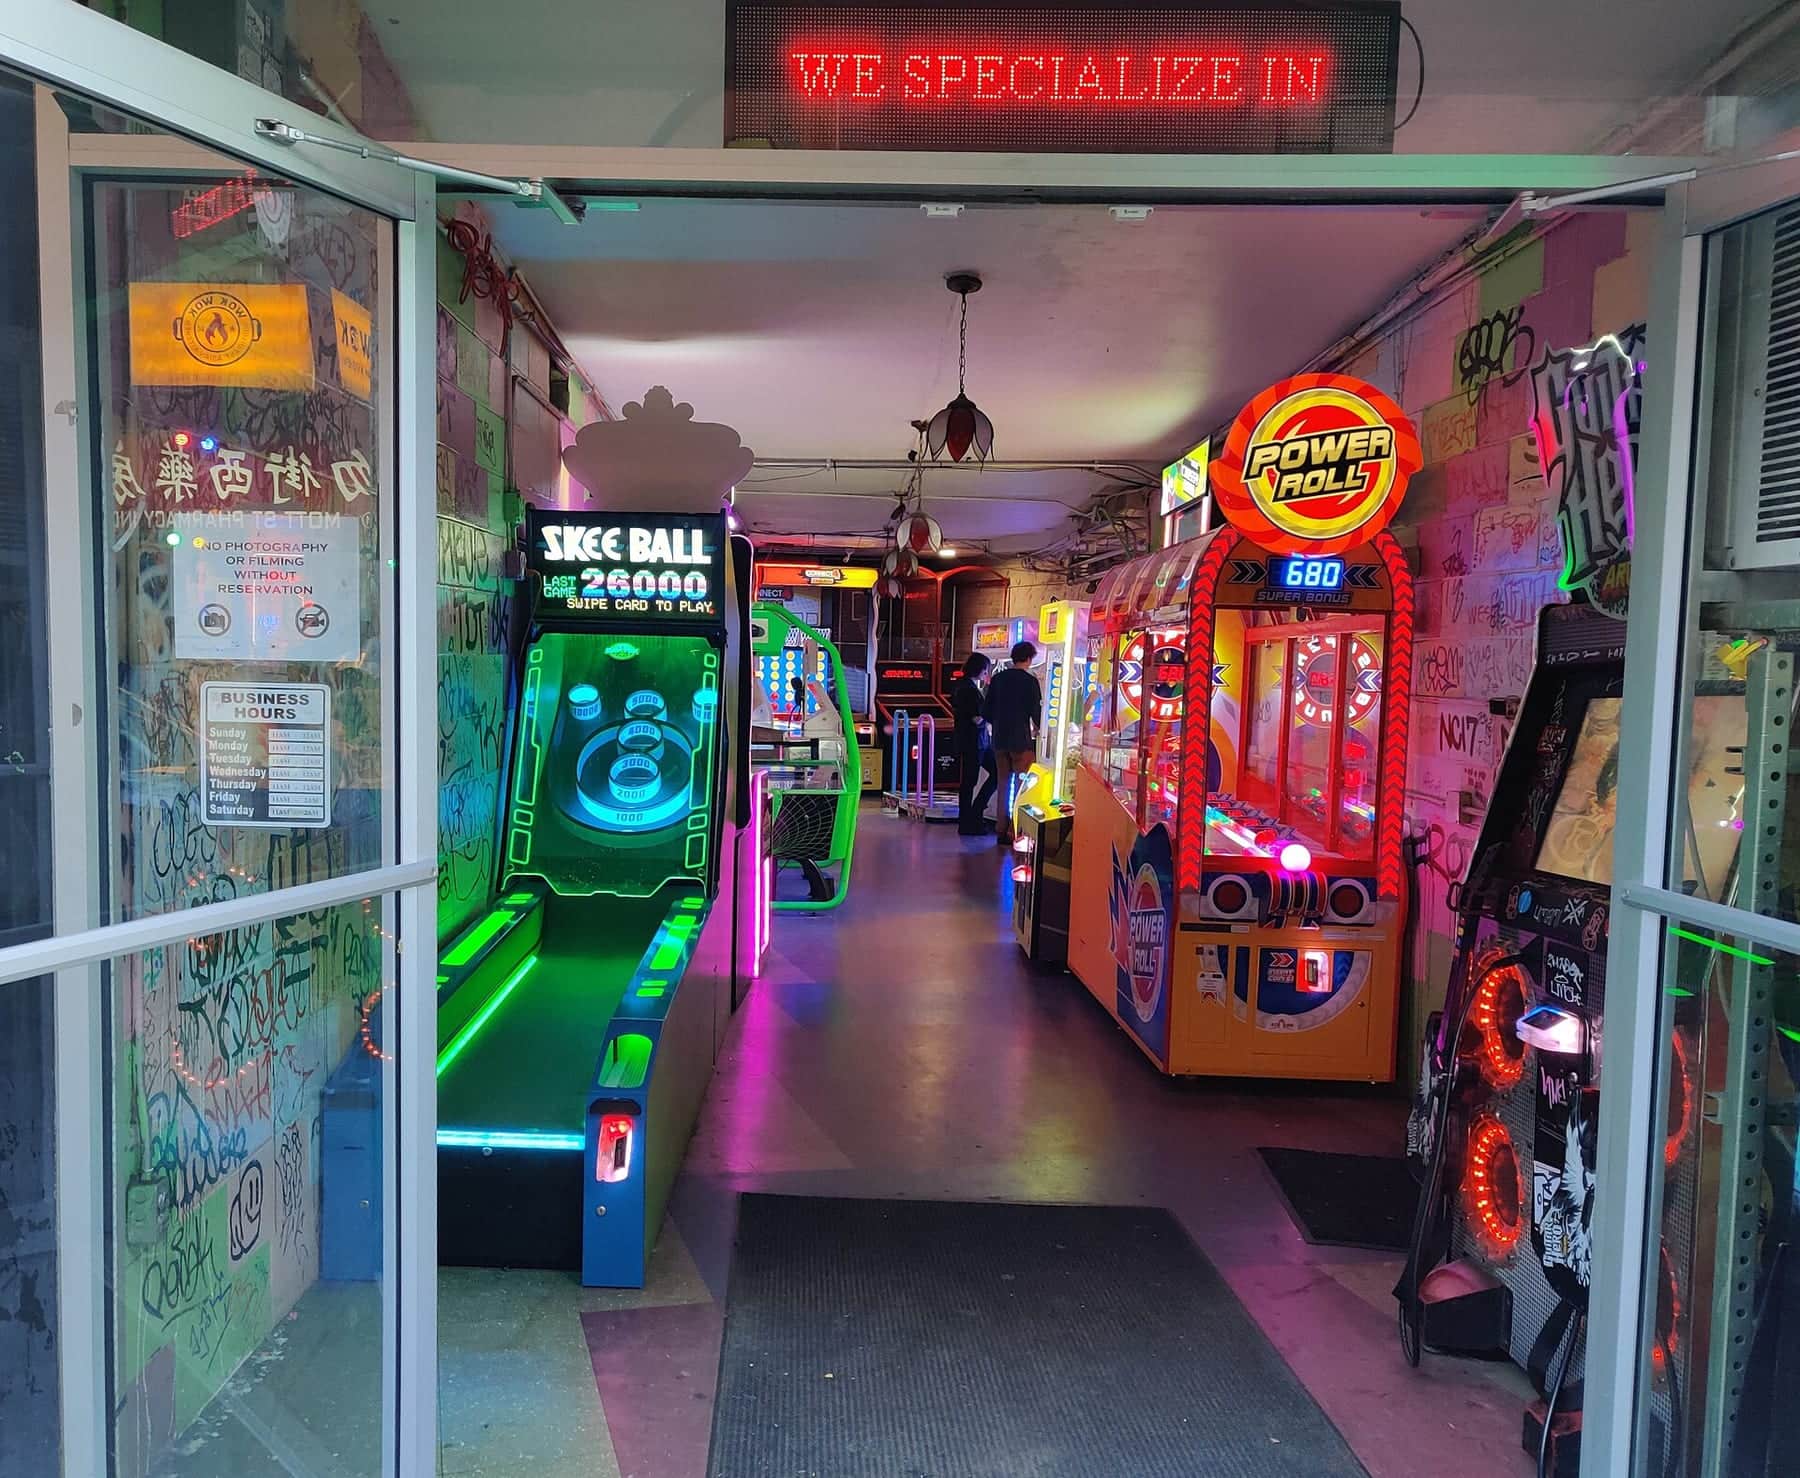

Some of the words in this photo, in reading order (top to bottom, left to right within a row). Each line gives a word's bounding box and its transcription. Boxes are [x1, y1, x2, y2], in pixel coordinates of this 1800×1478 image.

[792, 53, 885, 97] WE
[903, 54, 1241, 101] SPECIALIZE
[1261, 56, 1325, 101] IN
[1249, 428, 1392, 477] POWER
[1277, 464, 1366, 498] ROLL
[201, 542, 221, 551] NO
[225, 542, 328, 552] PHOTOGRAPHY
[541, 525, 621, 562] SKEE
[629, 527, 712, 564] BALL
[226, 557, 244, 565] OR
[249, 557, 304, 566] FILMING
[234, 571, 296, 580] WITHOUT
[1286, 560, 1341, 587] 680
[543, 575, 577, 587] LAST
[580, 567, 707, 599] 26000
[218, 584, 313, 595] RESERVATION
[543, 587, 577, 598] GAME
[1257, 591, 1301, 601] SUPER
[1306, 592, 1350, 603] BONUS
[566, 598, 608, 610] SWIPE
[615, 599, 649, 611] CARD
[656, 600, 673, 612] TO
[679, 601, 713, 613] PLAY
[220, 692, 310, 706] BUSINESS
[234, 707, 297, 720] HOURS
[209, 728, 246, 740] Sunday
[209, 740, 249, 752] Monday
[209, 753, 252, 765] Tuesday
[622, 758, 650, 768] 3000
[209, 766, 267, 779] Wednesday
[209, 778, 257, 792] Thursday
[209, 792, 241, 804] Friday
[616, 789, 646, 799] 2000
[209, 804, 255, 818] Saturday
[616, 813, 644, 822] 1000
[1130, 914, 1164, 943] POWER
[1134, 948, 1154, 973] ROLL
